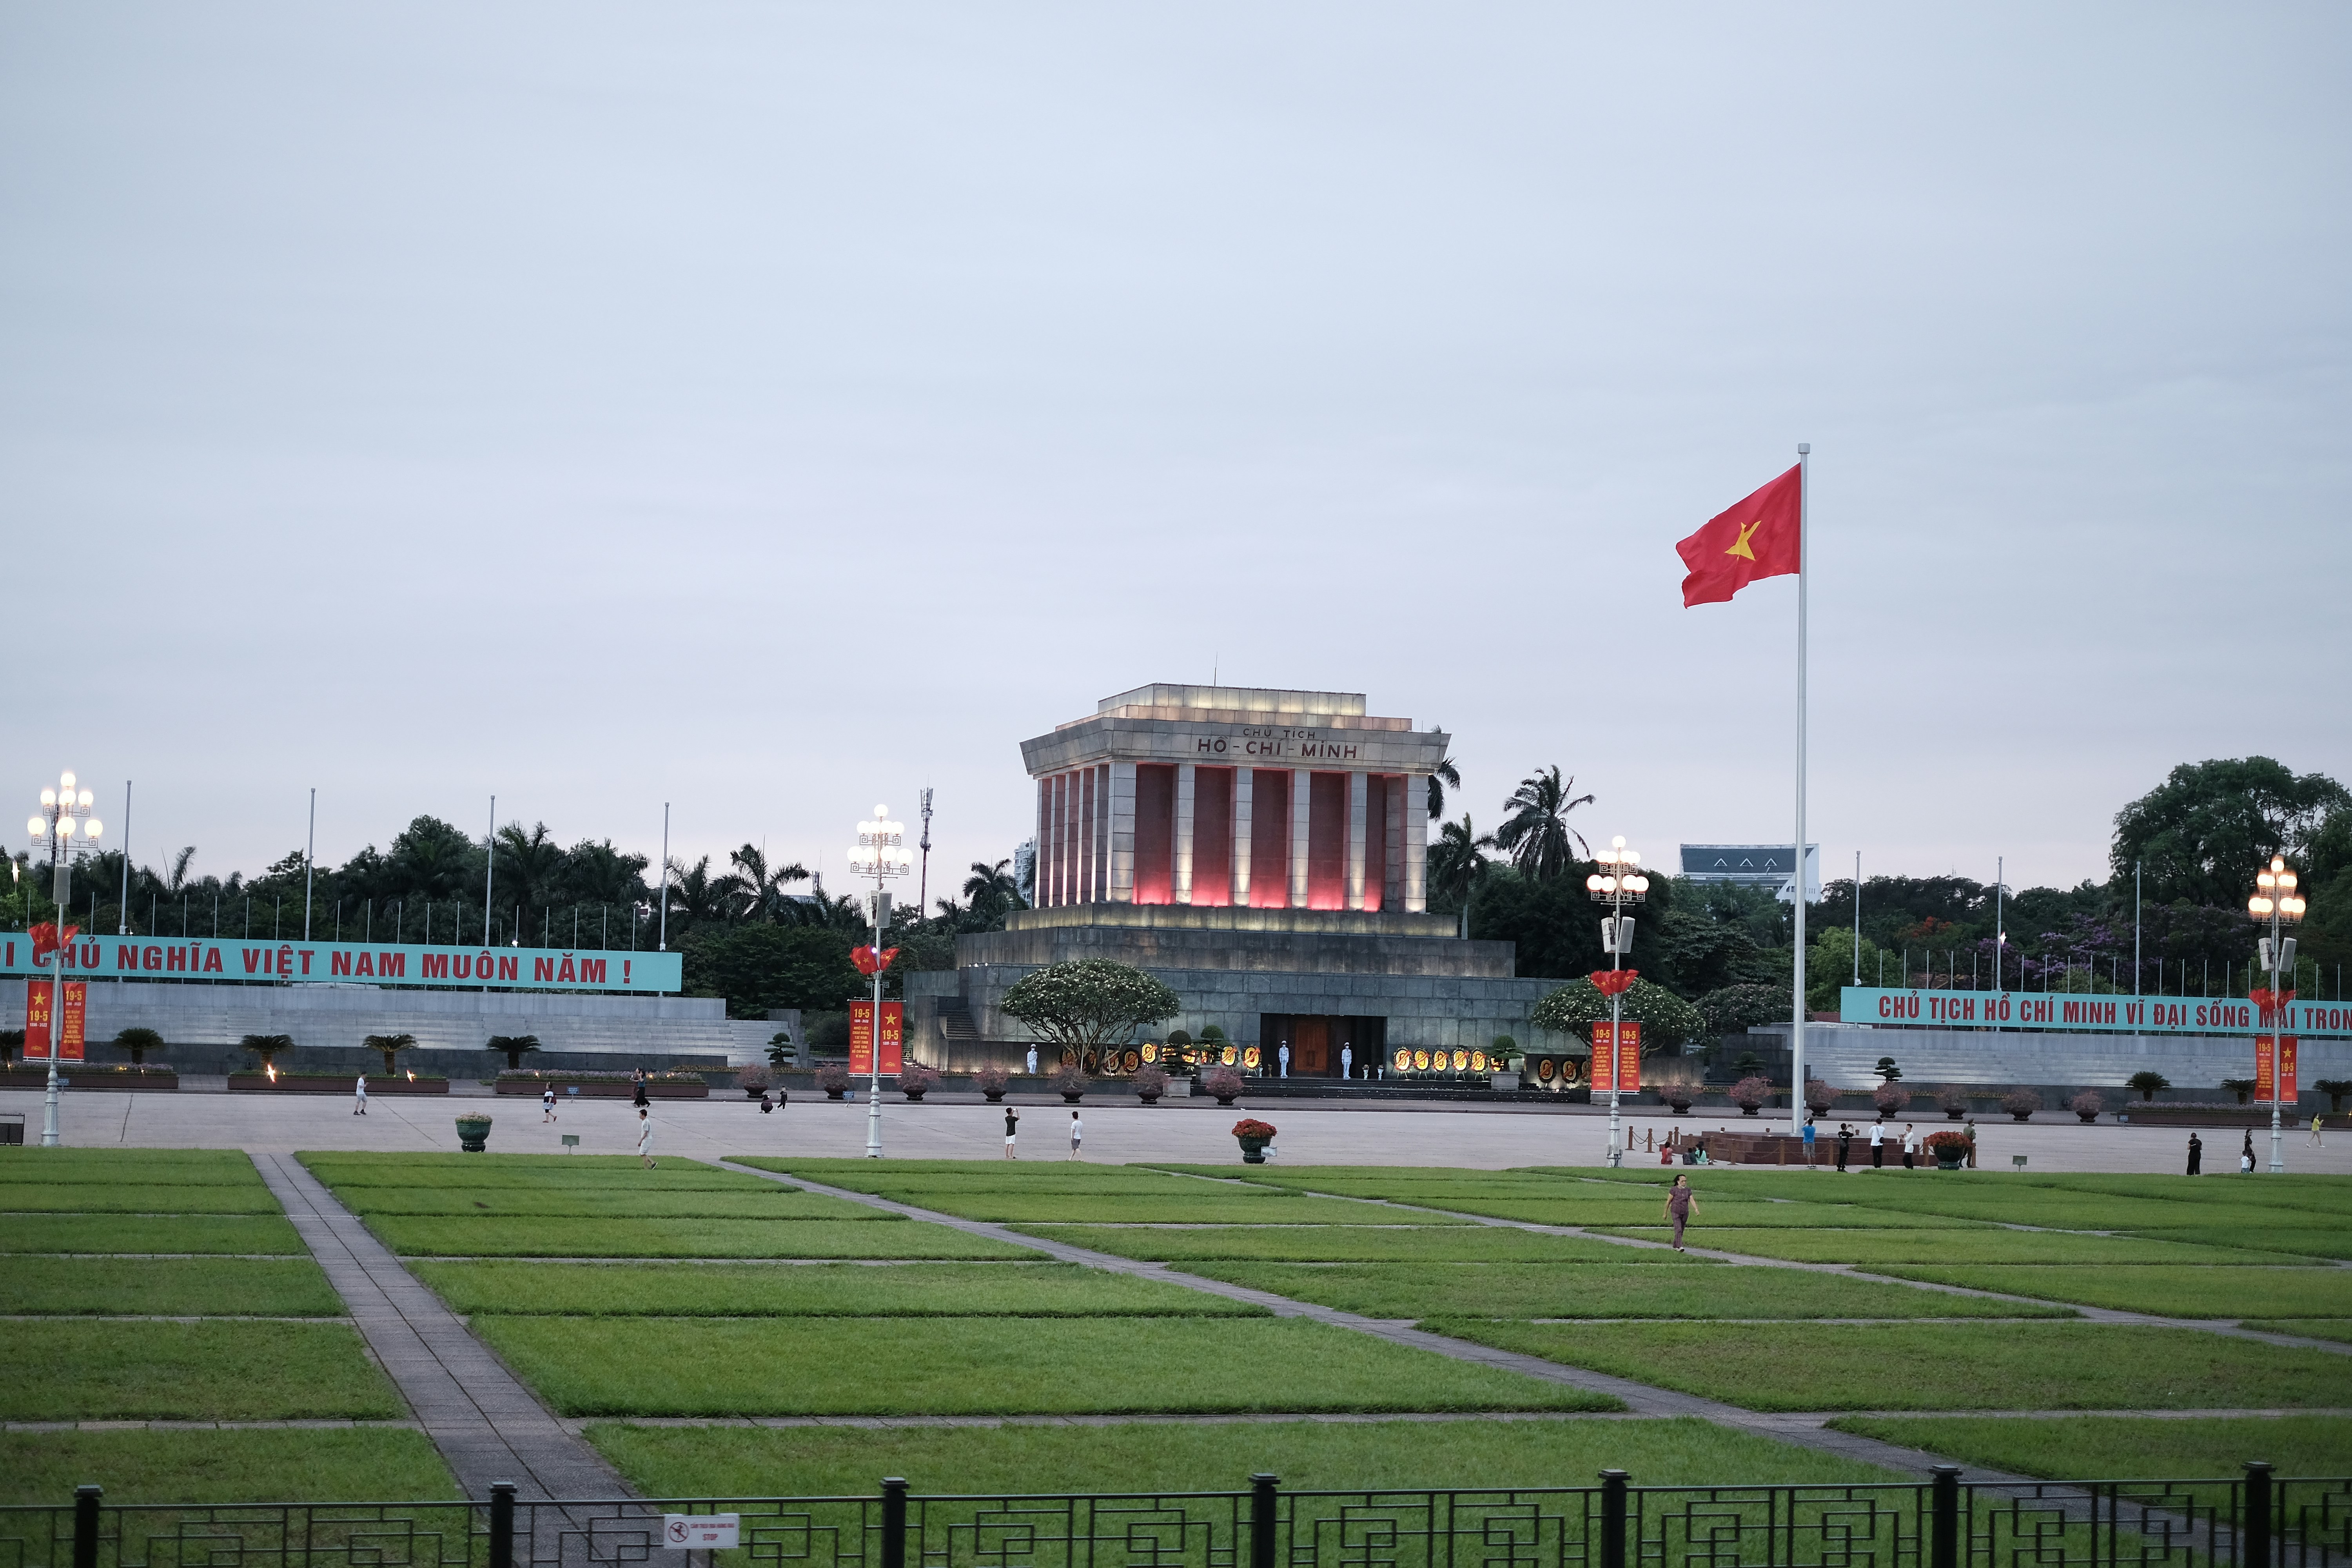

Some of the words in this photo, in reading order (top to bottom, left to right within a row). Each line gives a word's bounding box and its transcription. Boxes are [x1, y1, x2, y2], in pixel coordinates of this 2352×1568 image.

[1243, 726, 1271, 737] CHỦ
[1198, 736, 1228, 753] HỒ
[1246, 739, 1283, 755] CHÍ
[1301, 740, 1357, 759] MINH
[118, 942, 223, 972] NGHĨA
[242, 944, 314, 978] VIỆT
[332, 951, 405, 977] NAM
[422, 950, 518, 980] MUÔN
[535, 953, 606, 983] NĂM
[66, 991, 82, 1001] 19-5
[855, 1008, 870, 1018] 19-5
[1879, 990, 1920, 1018] CHỦ
[1929, 997, 1975, 1023] TỊCH
[1985, 993, 2010, 1021] HỒ
[2020, 996, 2054, 1022] CHÍ
[2063, 1001, 2116, 1024] MINH
[2126, 999, 2145, 1024] VĨ
[2153, 1004, 2187, 1029] ĐẠI
[2196, 998, 2249, 1027] SỐNG
[30, 1010, 48, 1022] 19-5
[882, 1029, 899, 1040] 19-5
[1596, 1029, 1610, 1038] 19-5
[1622, 1030, 1636, 1040] 19-5
[2259, 1043, 2271, 1052] 19-5
[2281, 1062, 2294, 1072] 19-5
